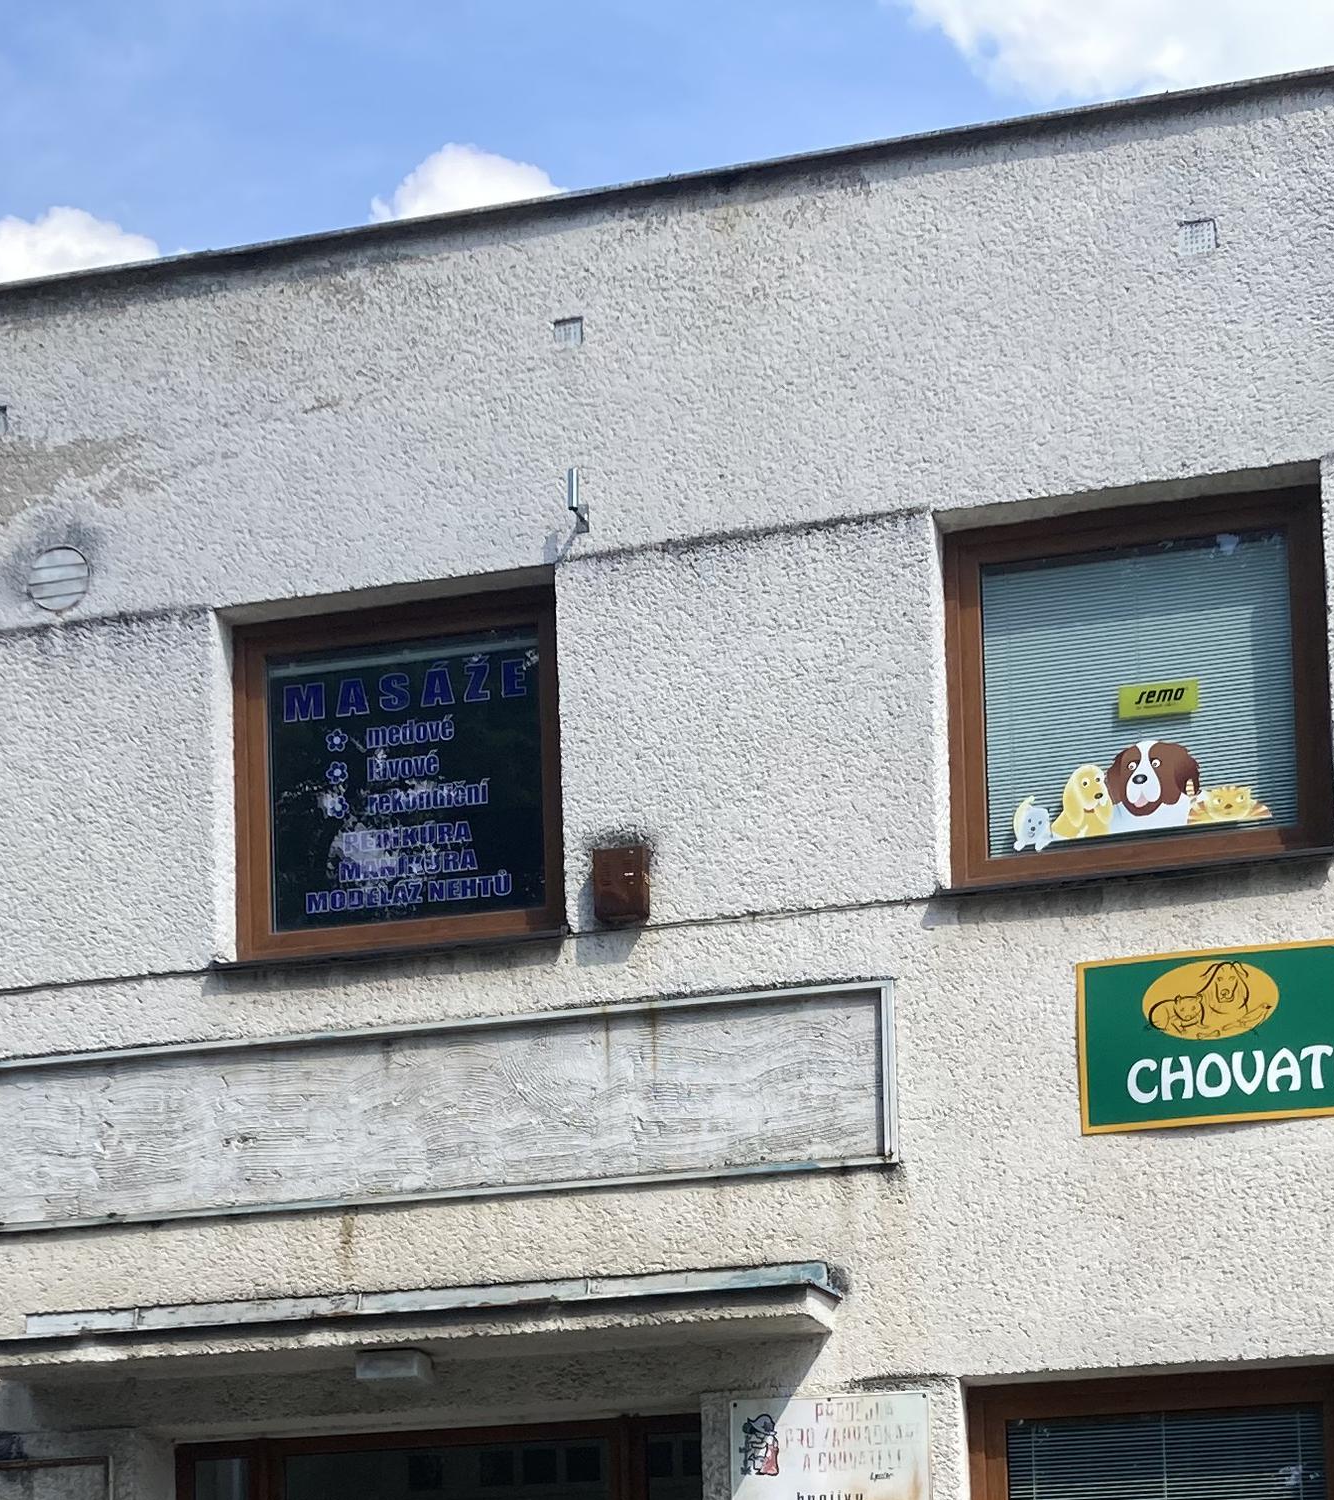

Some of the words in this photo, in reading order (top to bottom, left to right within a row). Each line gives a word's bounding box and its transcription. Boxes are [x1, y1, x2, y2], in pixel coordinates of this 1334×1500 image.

[283, 654, 528, 722] MASÁŽE
[1135, 687, 1185, 705] semo
[366, 714, 455, 749] medové
[428, 869, 513, 902] NEHTŮ
